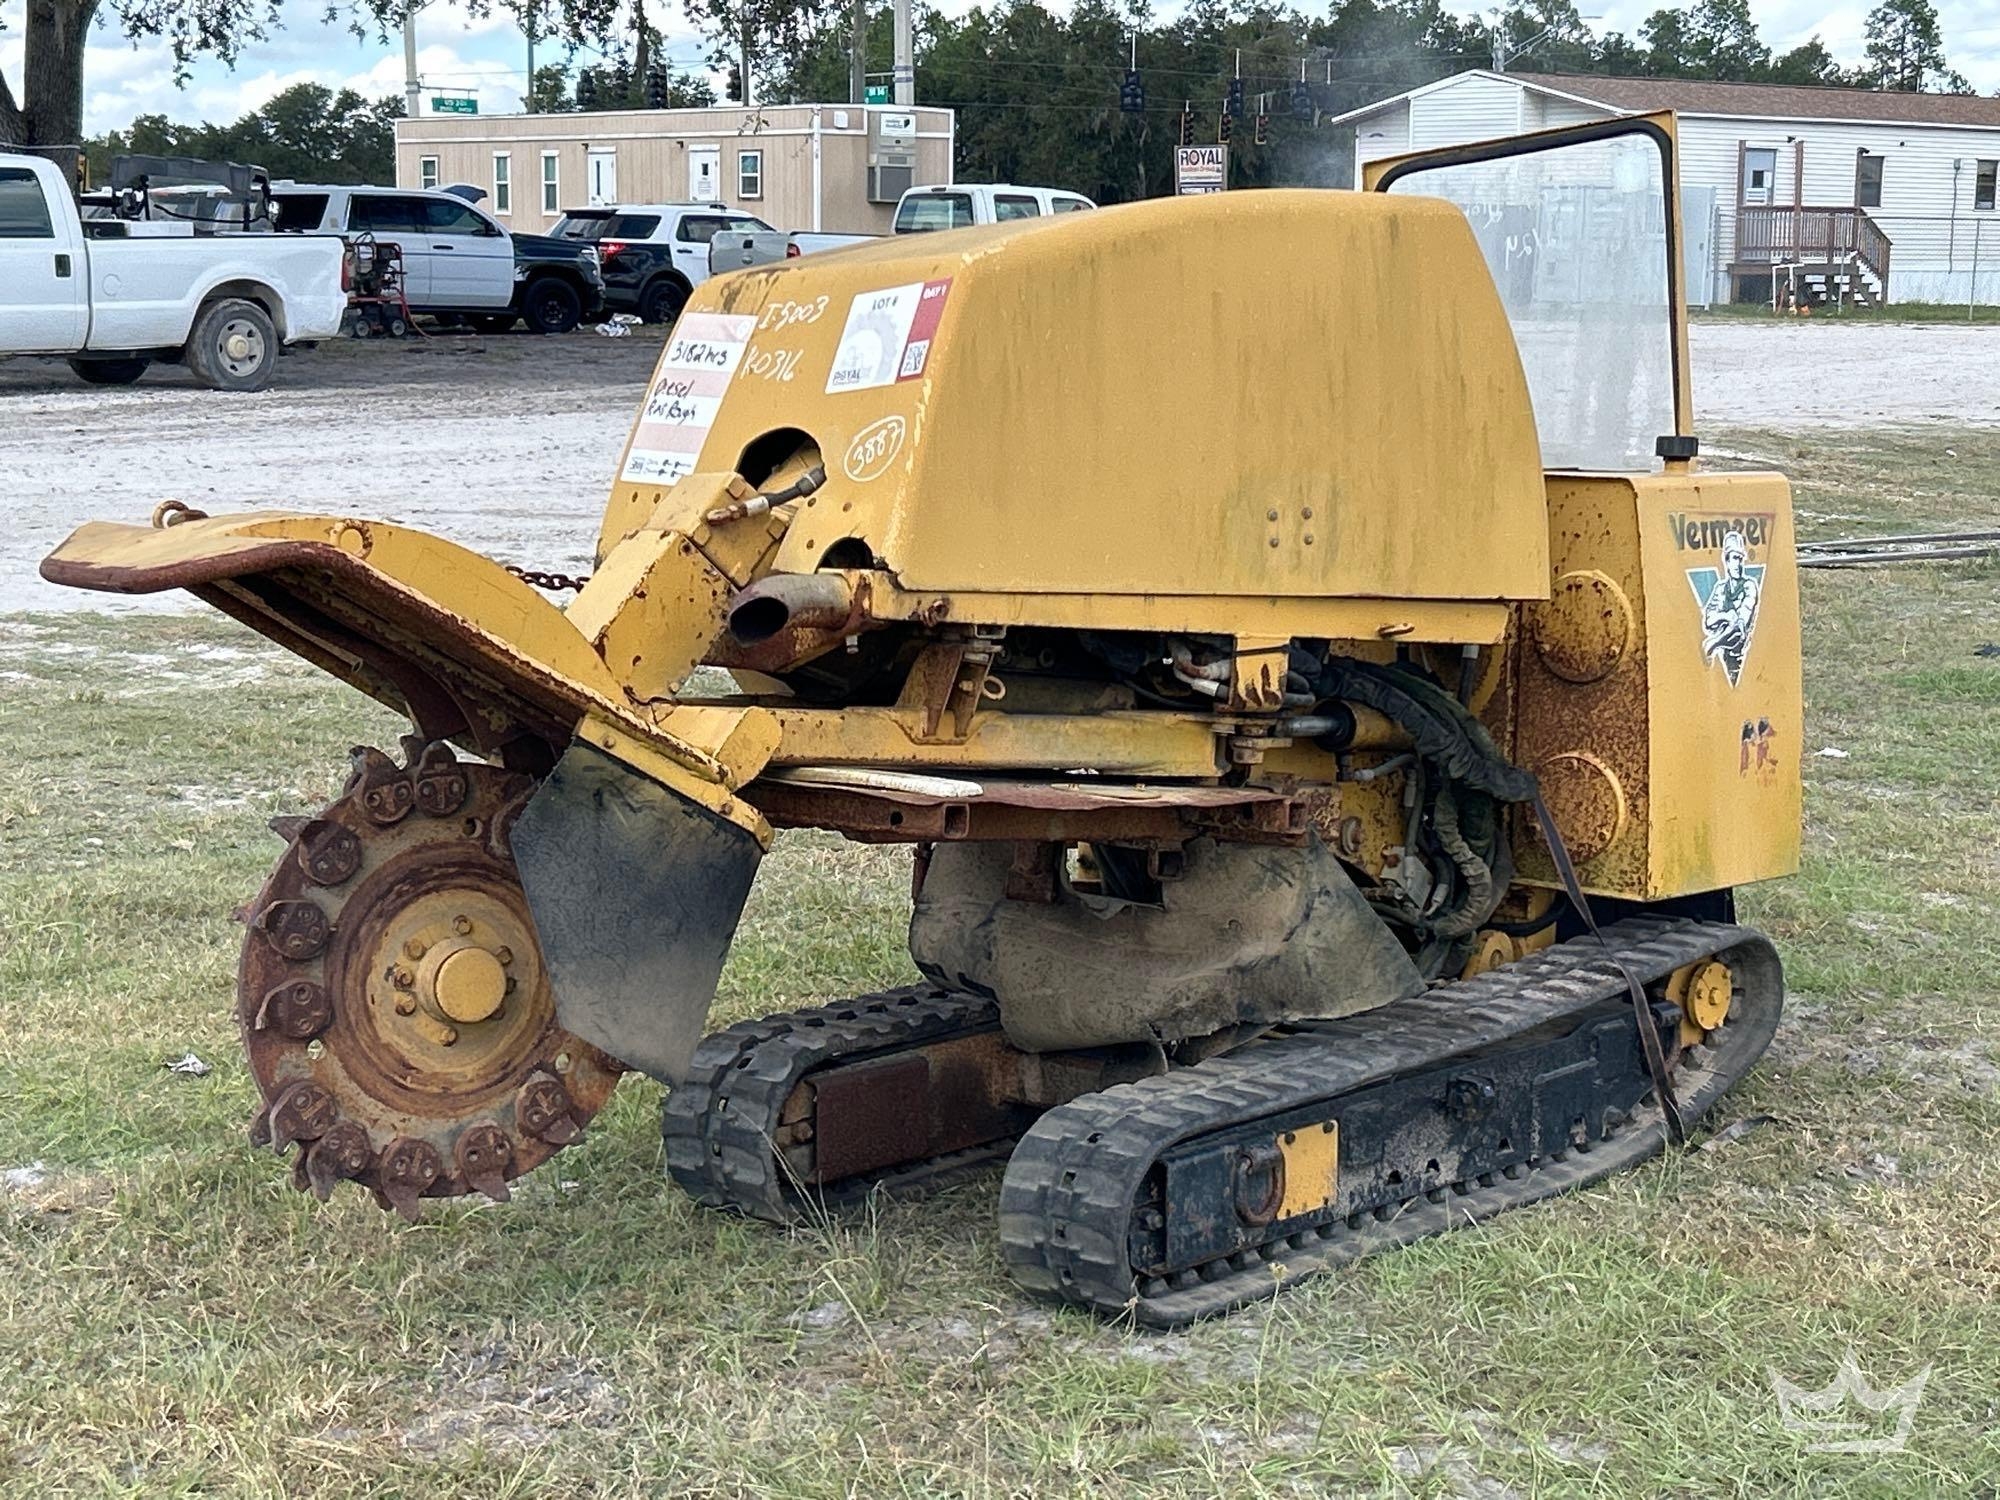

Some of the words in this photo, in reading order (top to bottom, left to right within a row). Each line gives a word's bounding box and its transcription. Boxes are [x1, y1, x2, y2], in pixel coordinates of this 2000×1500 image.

[1180, 149, 1222, 166] ROYAL
[872, 297, 891, 310] LOT
[852, 421, 898, 476] 3887
[1667, 511, 1768, 551] Vermeer
